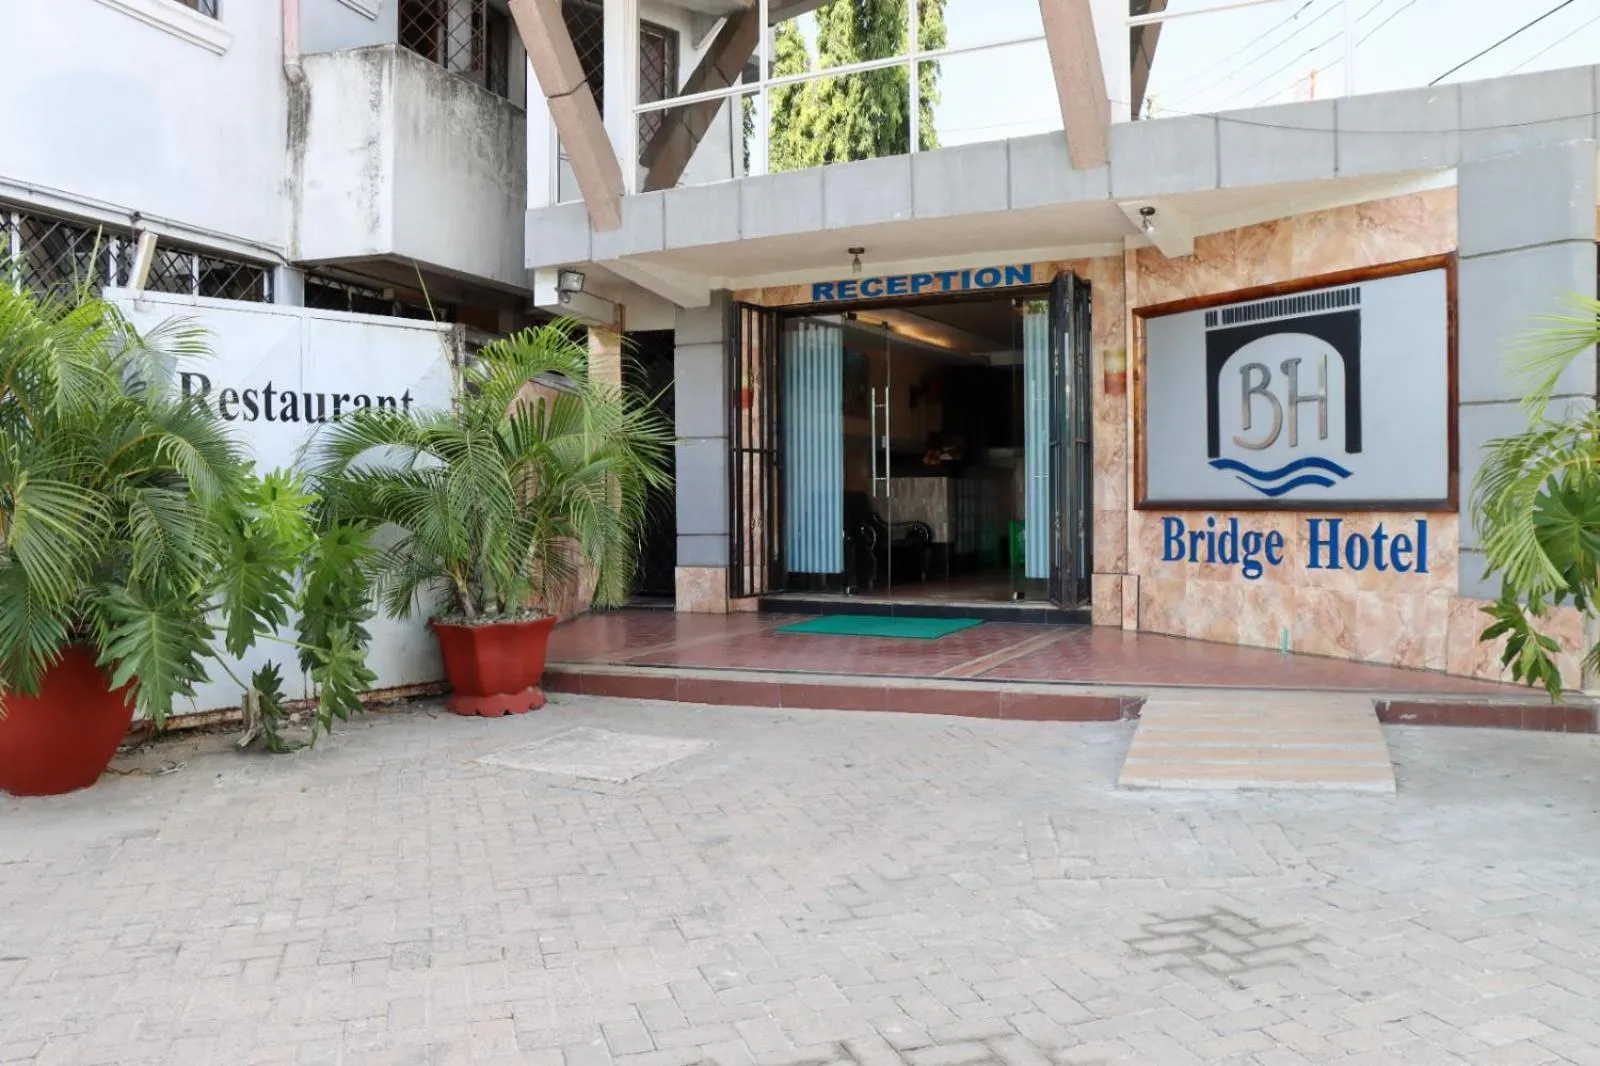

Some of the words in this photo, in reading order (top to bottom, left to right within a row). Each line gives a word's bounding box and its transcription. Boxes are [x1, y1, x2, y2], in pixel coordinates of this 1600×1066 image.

[812, 264, 1032, 302] RECEPTION
[1231, 354, 1328, 451] BH
[1161, 515, 1285, 580] Bridge
[1306, 517, 1429, 573] Hotel
